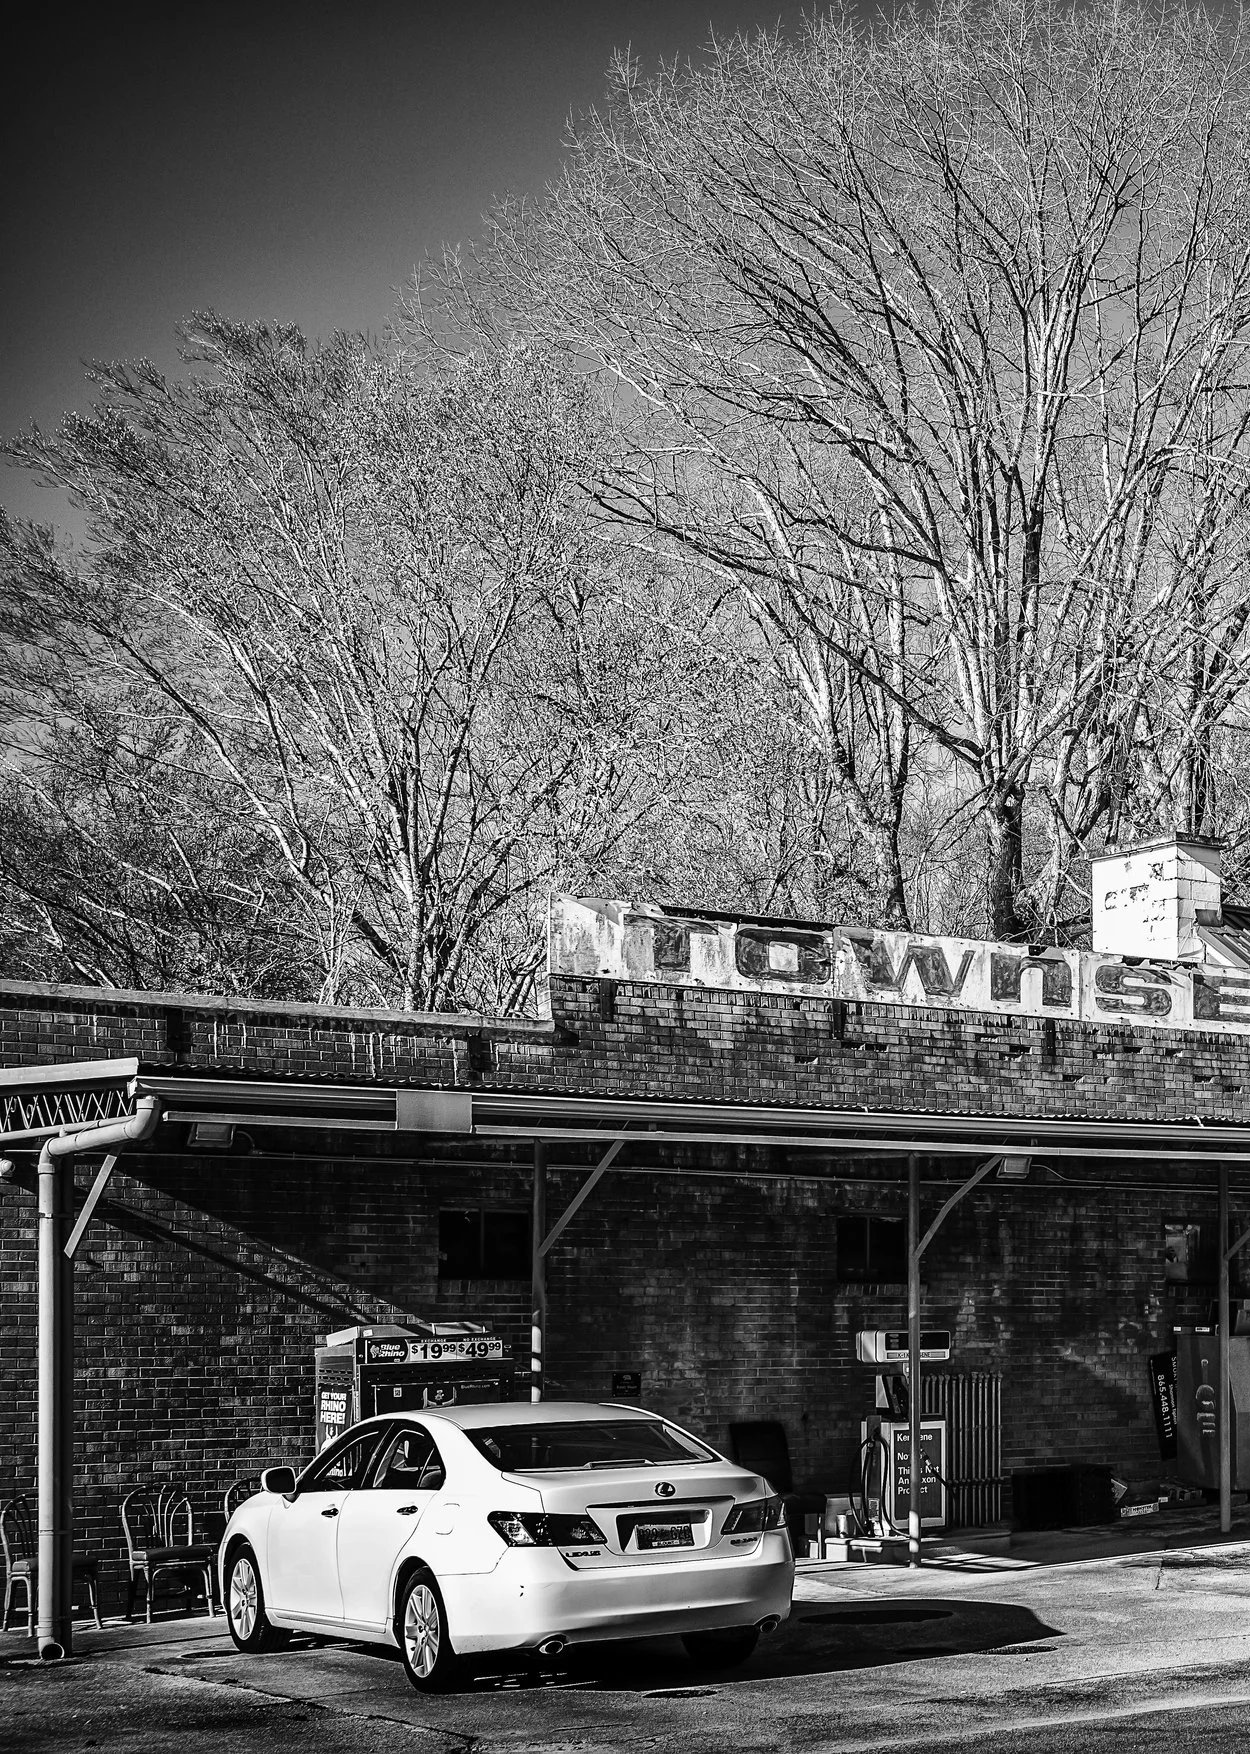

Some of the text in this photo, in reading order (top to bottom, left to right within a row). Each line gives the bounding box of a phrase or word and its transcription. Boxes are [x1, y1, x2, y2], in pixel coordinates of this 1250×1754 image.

[378, 1349, 405, 1357] Rhino
[321, 1391, 347, 1401] GET YOUR
[320, 1400, 346, 1412] RHINO
[1157, 1374, 1173, 1438] 865.448.1111
[320, 1411, 346, 1425] HERE!
[896, 1433, 933, 1442] Kerene
[897, 1466, 910, 1475] Thi
[898, 1477, 910, 1485] An
